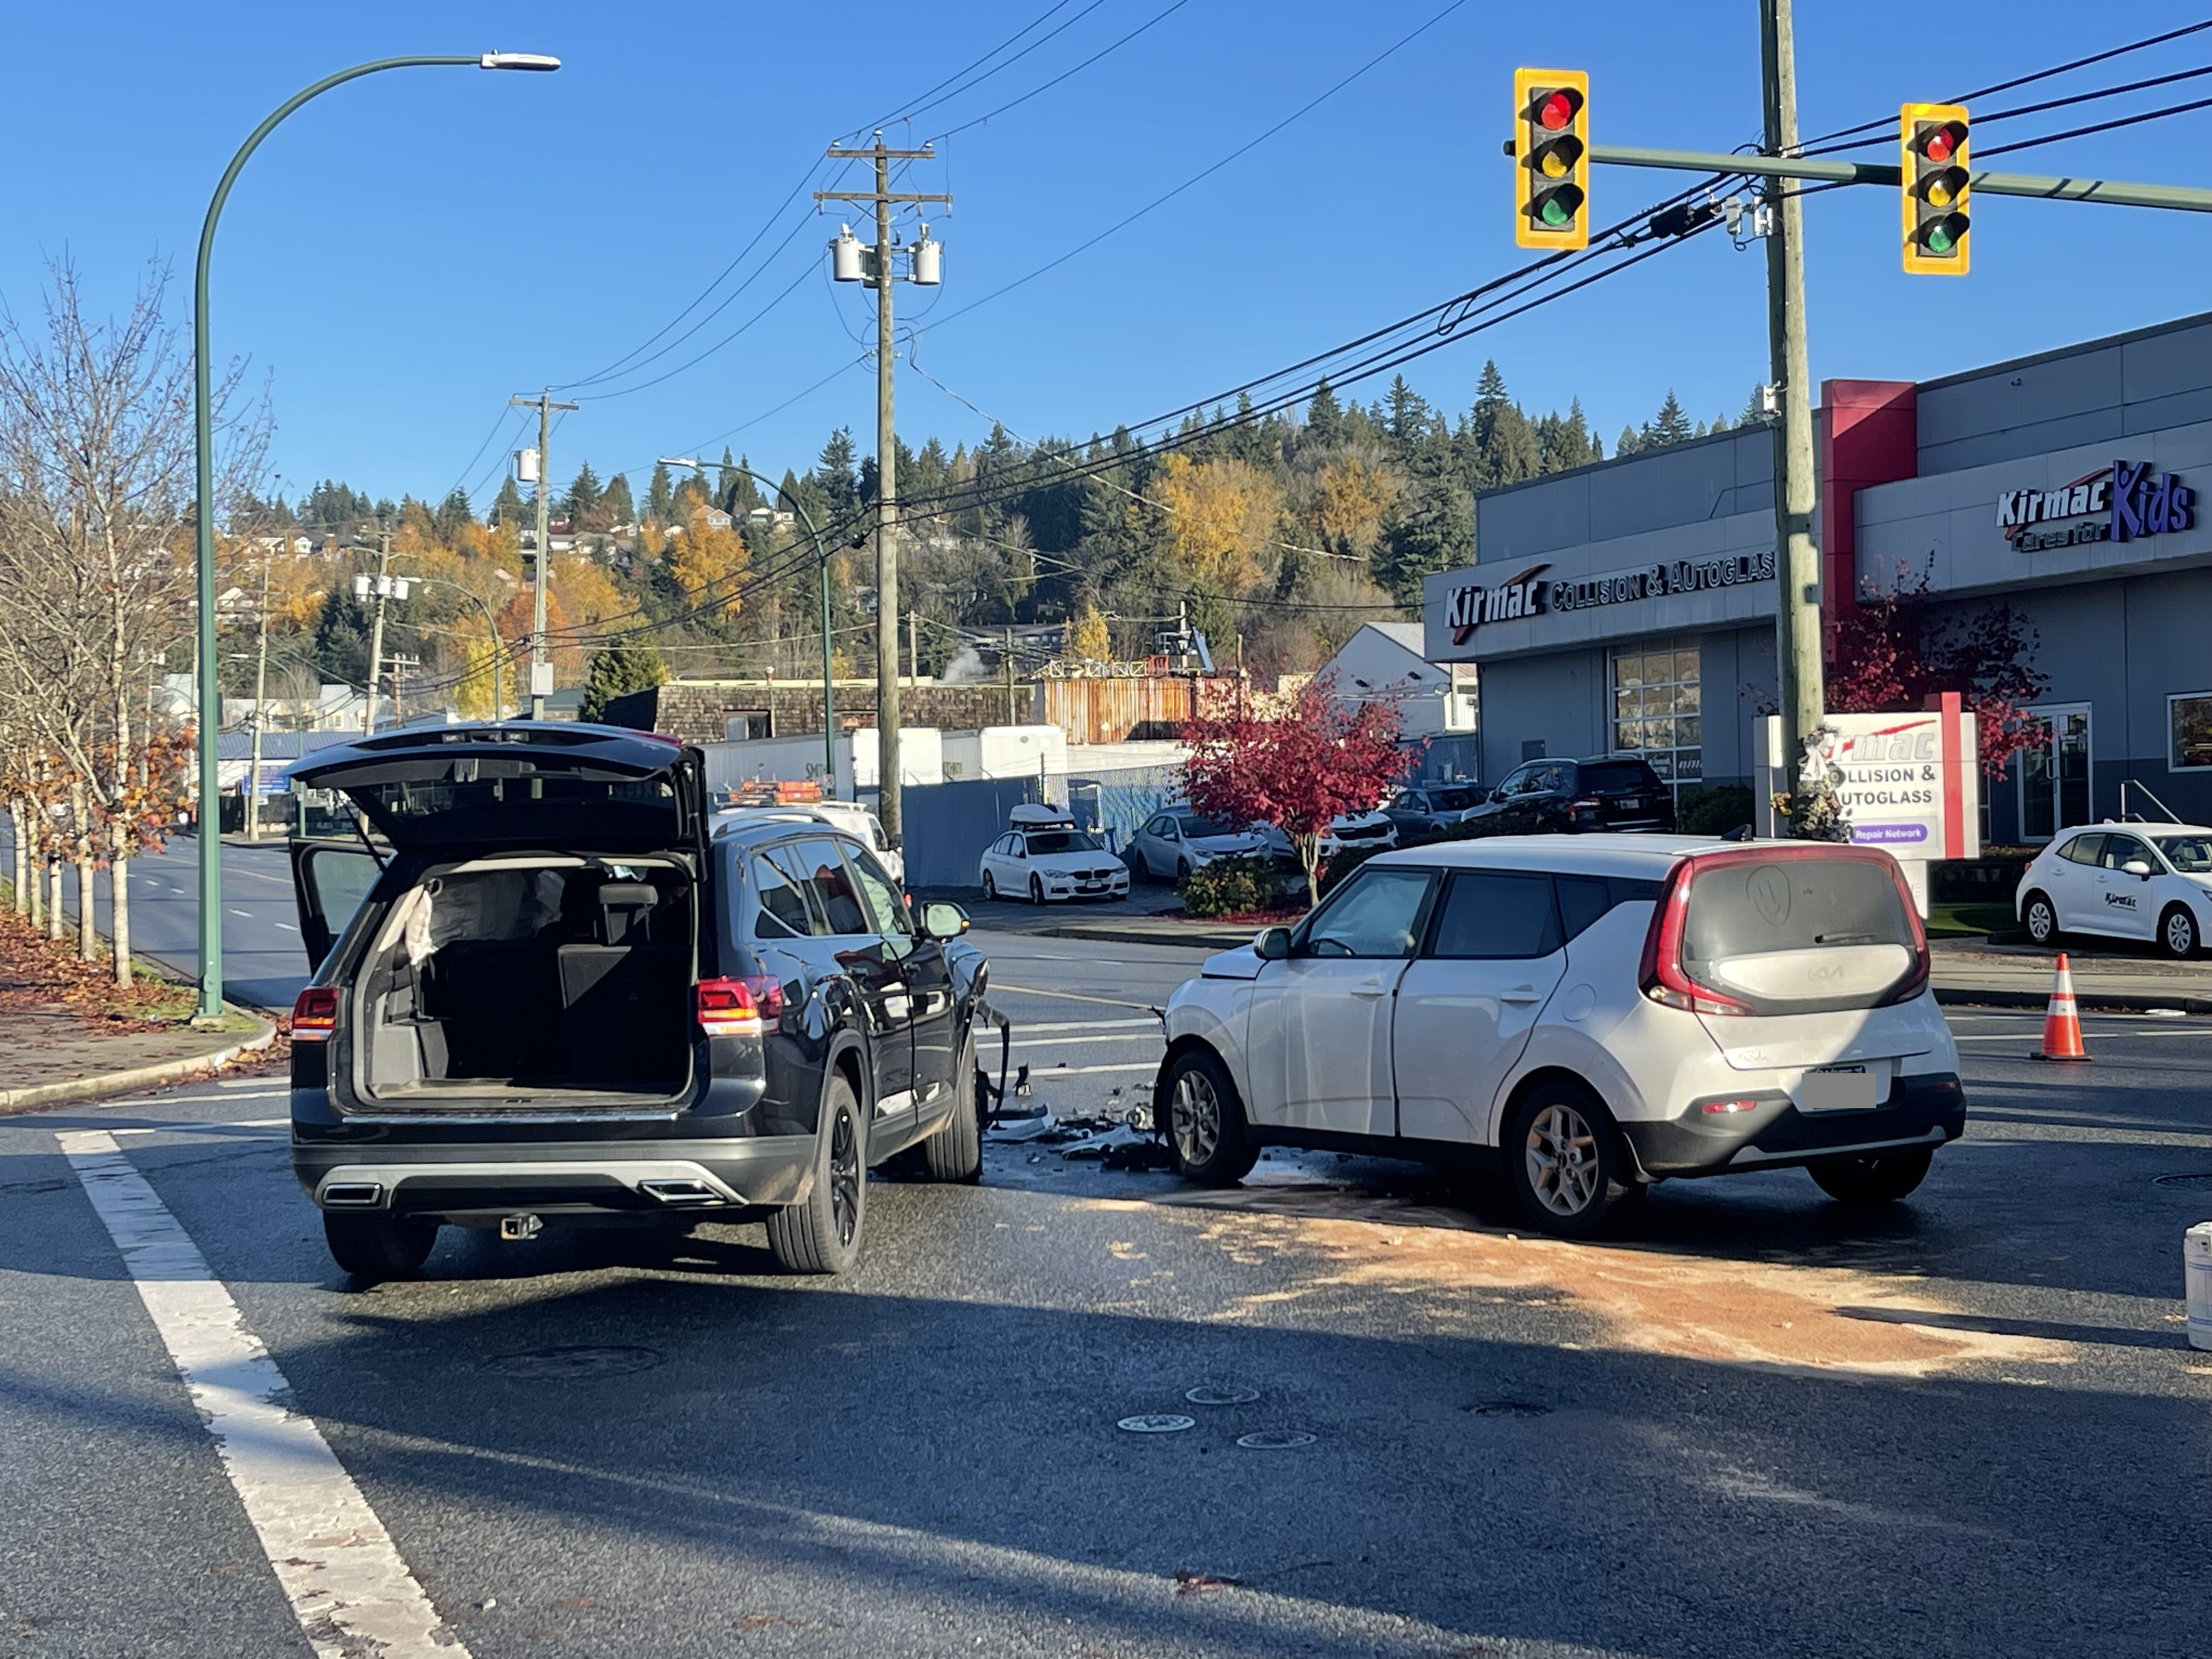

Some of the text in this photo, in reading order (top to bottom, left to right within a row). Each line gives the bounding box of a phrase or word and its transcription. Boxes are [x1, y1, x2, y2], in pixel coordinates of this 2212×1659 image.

[1996, 482, 2105, 527] Kirmac
[2111, 460, 2188, 542] Kids
[2011, 522, 2106, 552] Cares for
[1552, 551, 1775, 611] COLLISION & AUTOGLAS
[1443, 582, 1538, 628] Kirmac
[1831, 733, 1935, 761] rmac
[1848, 765, 1935, 783] LLISION &
[1841, 791, 1932, 805] UTOGLASS
[1855, 828, 1921, 840] Repair Network
